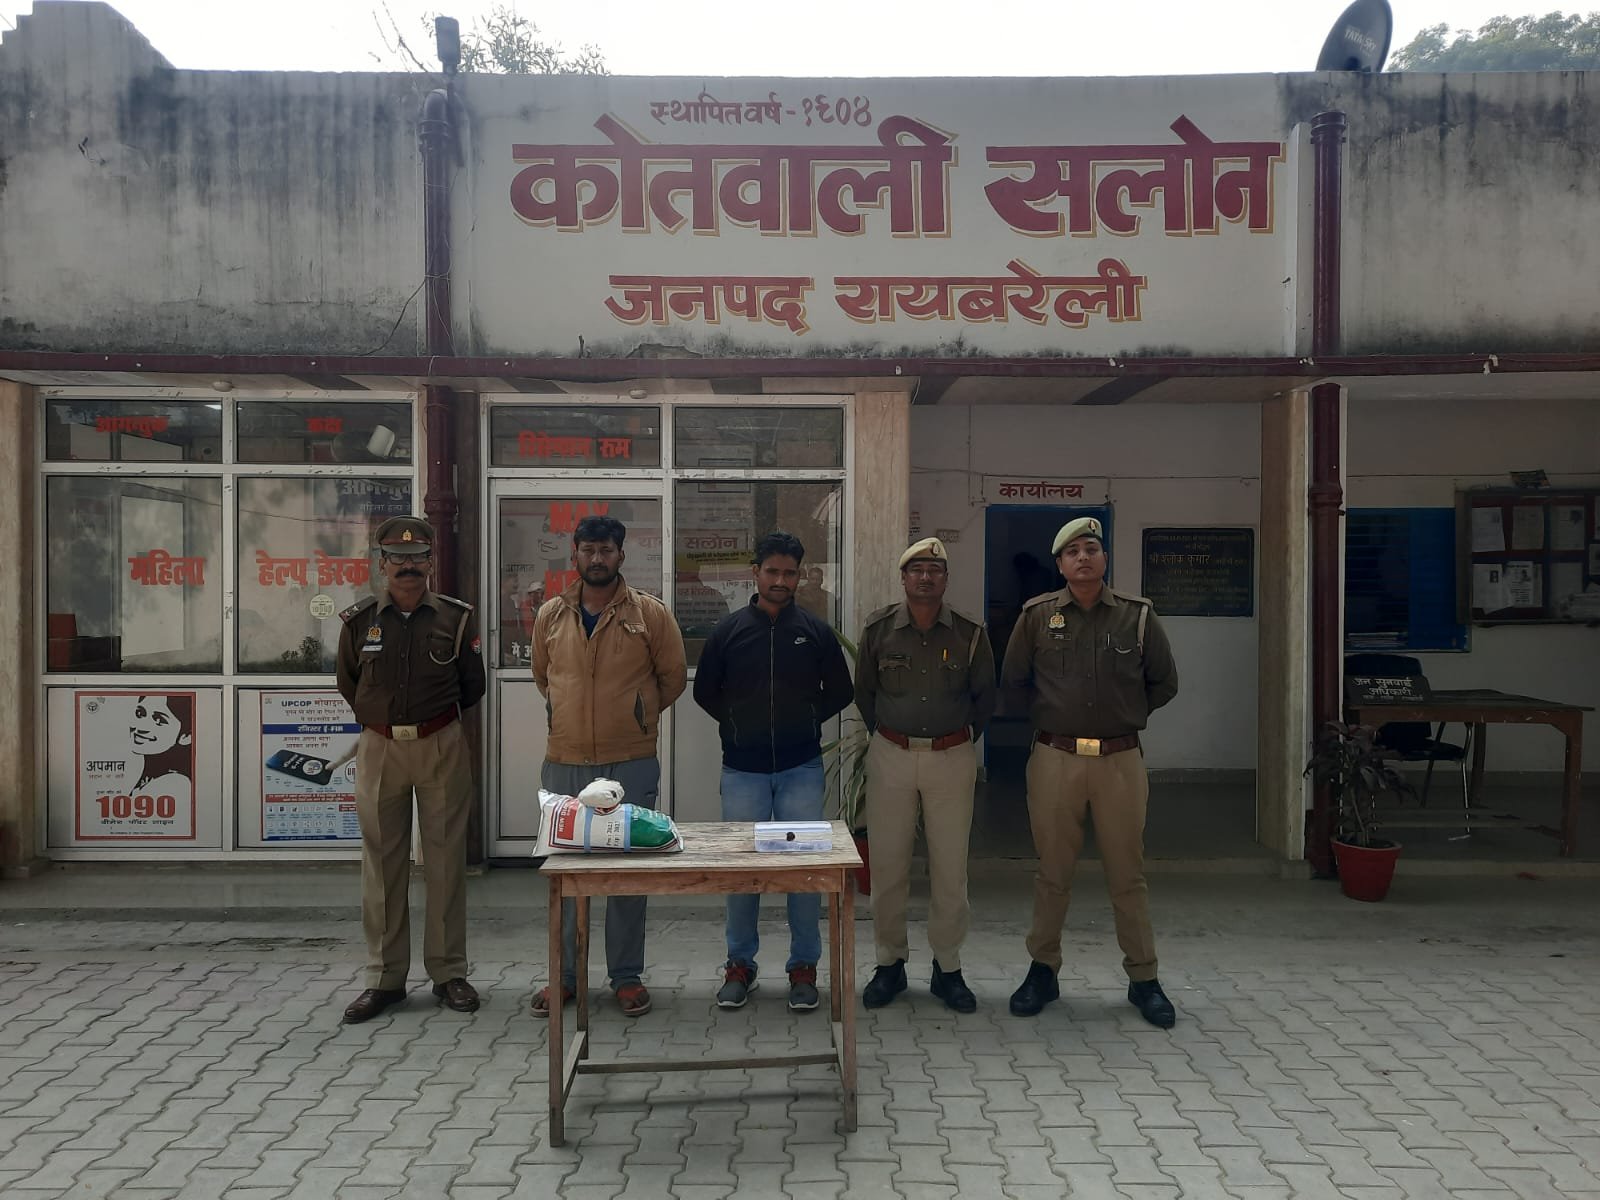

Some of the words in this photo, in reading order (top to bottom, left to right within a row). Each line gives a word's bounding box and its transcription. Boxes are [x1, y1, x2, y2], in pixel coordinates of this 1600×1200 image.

[510, 113, 957, 238] कोतवाली
[984, 114, 1286, 238] सलोन
[604, 275, 814, 335] जनपद
[834, 257, 1147, 329] रायबरेली
[1000, 481, 1083, 499] कार्यालय
[128, 549, 206, 586] महिला
[255, 549, 310, 586] हेल्प
[314, 549, 372, 586] डेस्क
[86, 760, 125, 772] अपमान
[96, 795, 175, 818] 1090
